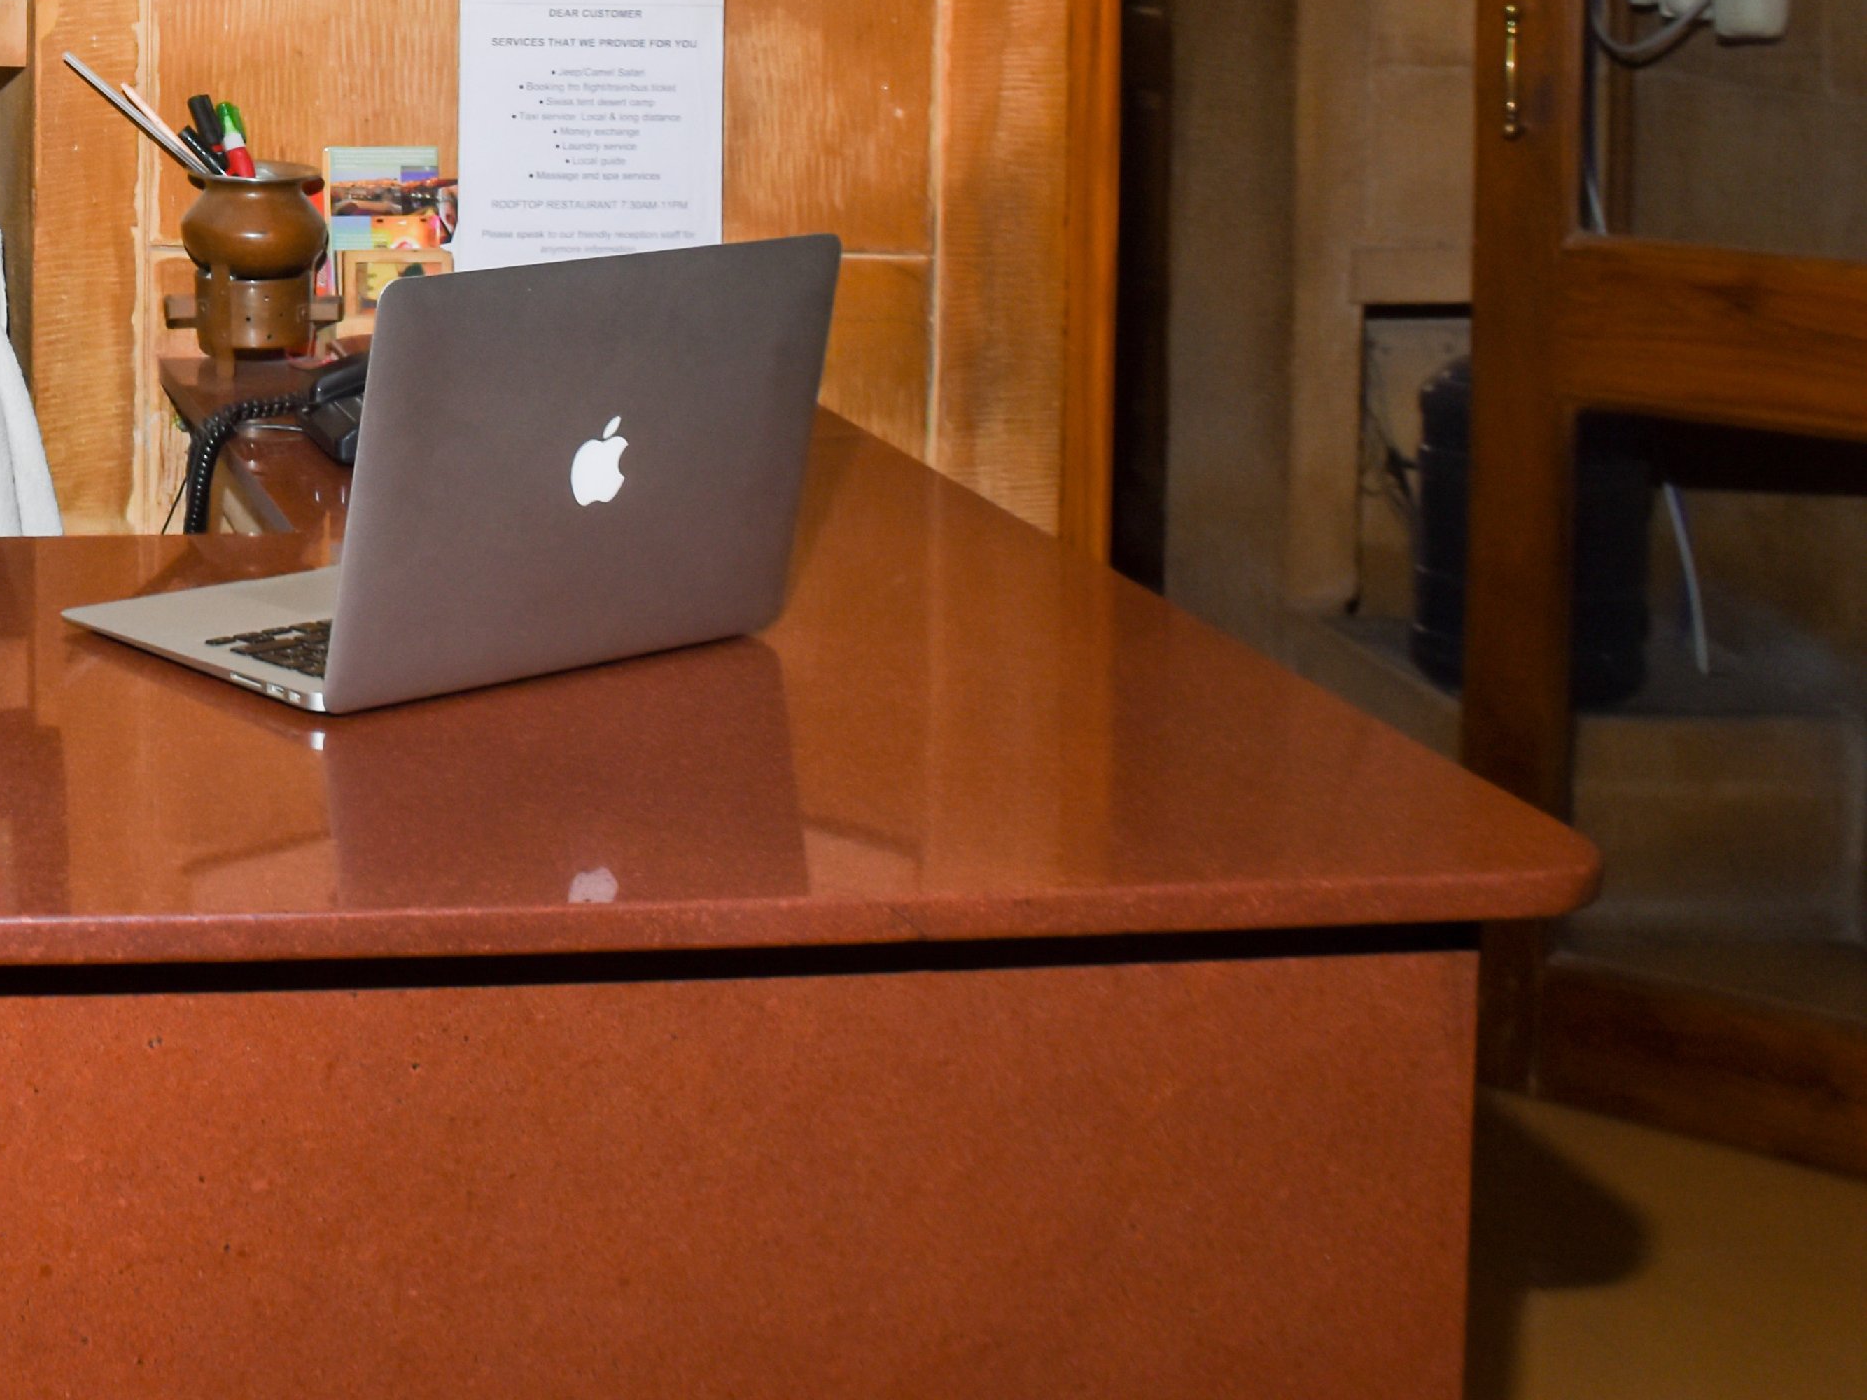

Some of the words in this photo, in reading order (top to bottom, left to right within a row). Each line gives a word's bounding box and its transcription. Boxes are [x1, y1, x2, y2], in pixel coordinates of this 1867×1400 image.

[549, 9, 579, 18] DEAR
[582, 9, 642, 18] CUSTOMER
[491, 37, 545, 47] SERVICES
[548, 38, 575, 47] THAT
[579, 38, 595, 47] WE
[599, 39, 645, 48] PROVIDE
[649, 39, 671, 48] FOR
[675, 39, 697, 48] YOU
[491, 200, 543, 209] ROOFTOP
[546, 200, 618, 209] RESTAURANT
